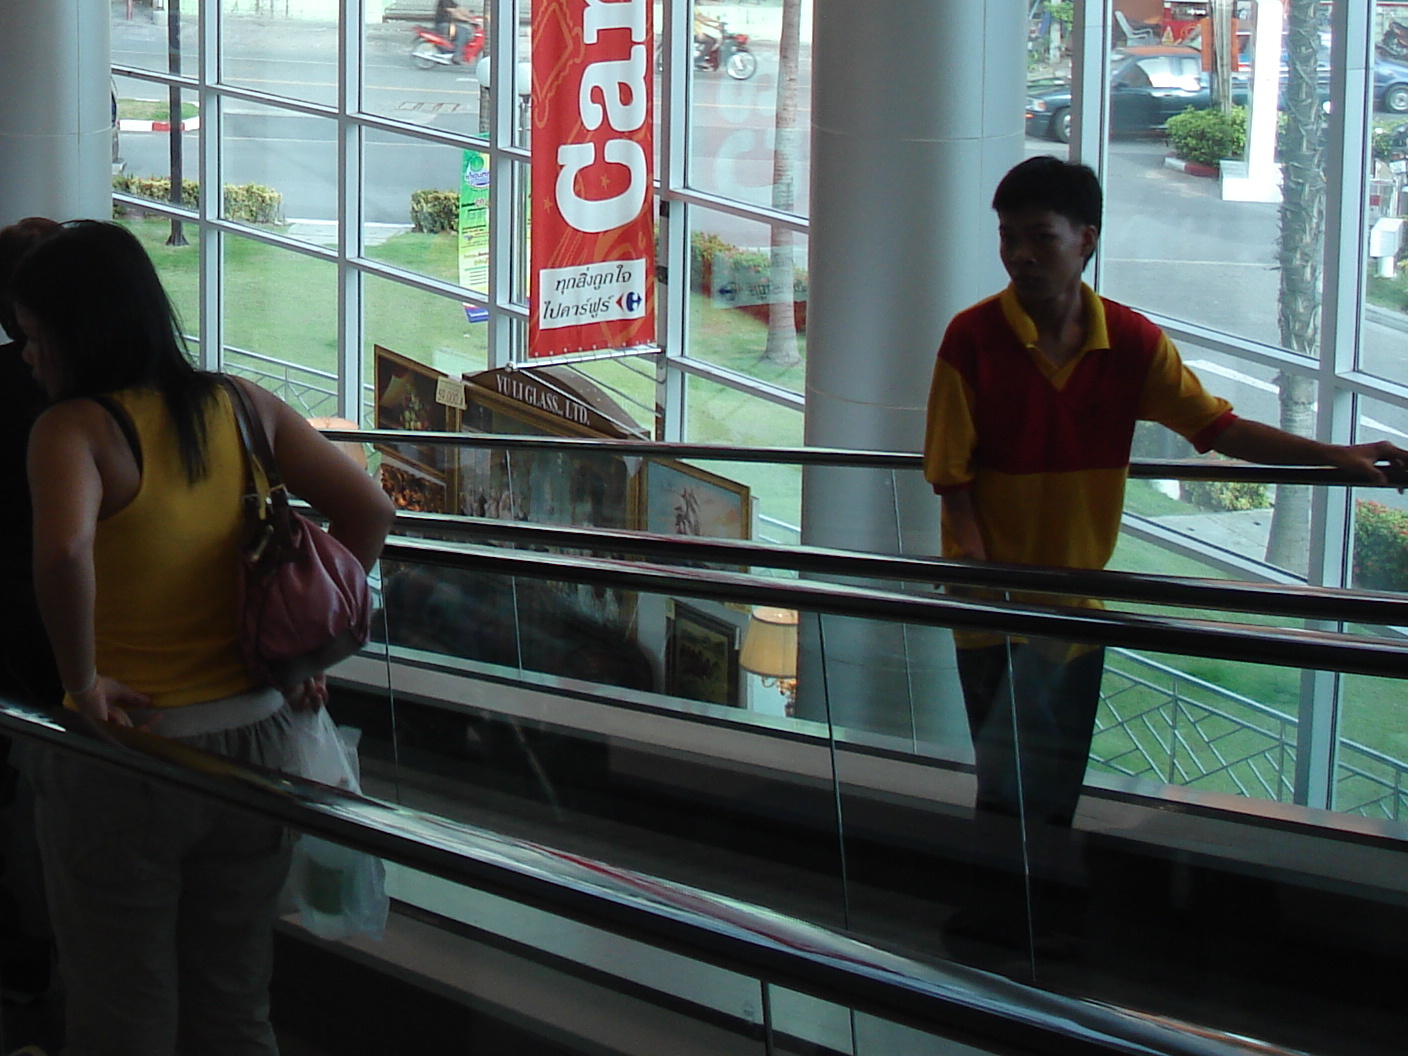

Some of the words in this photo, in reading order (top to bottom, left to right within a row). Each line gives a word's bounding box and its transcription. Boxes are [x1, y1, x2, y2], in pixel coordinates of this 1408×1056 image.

[555, 265, 632, 295] ทุกสิ่งถูกใจ
[543, 295, 614, 319] ไปคาร์ฟูร์
[496, 374, 511, 396] YU
[512, 380, 523, 400] LI
[565, 399, 590, 426] LTD.
